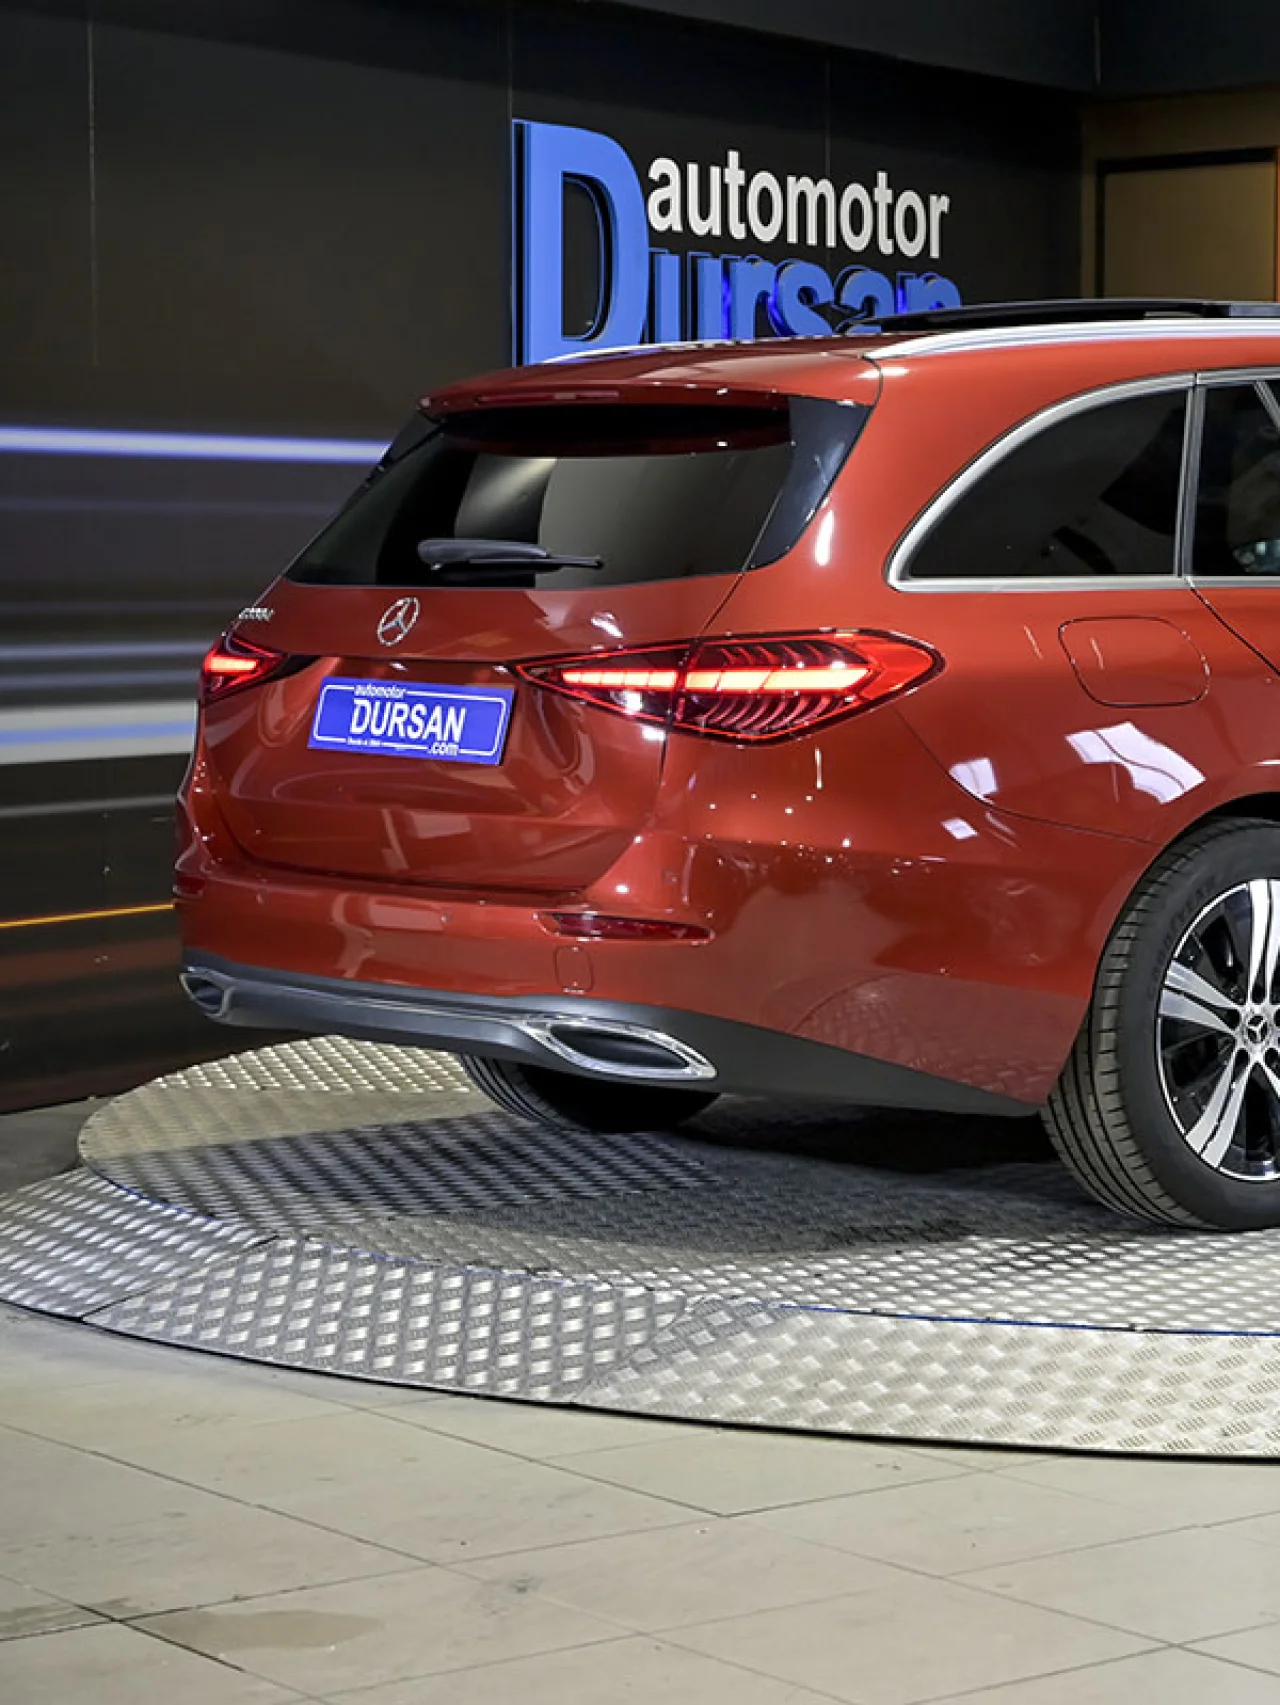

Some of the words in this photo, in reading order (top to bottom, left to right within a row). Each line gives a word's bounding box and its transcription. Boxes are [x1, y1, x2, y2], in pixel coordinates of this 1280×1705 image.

[648, 150, 950, 259] automotor
[350, 699, 467, 742] DURSAN
[427, 741, 460, 756] .com
